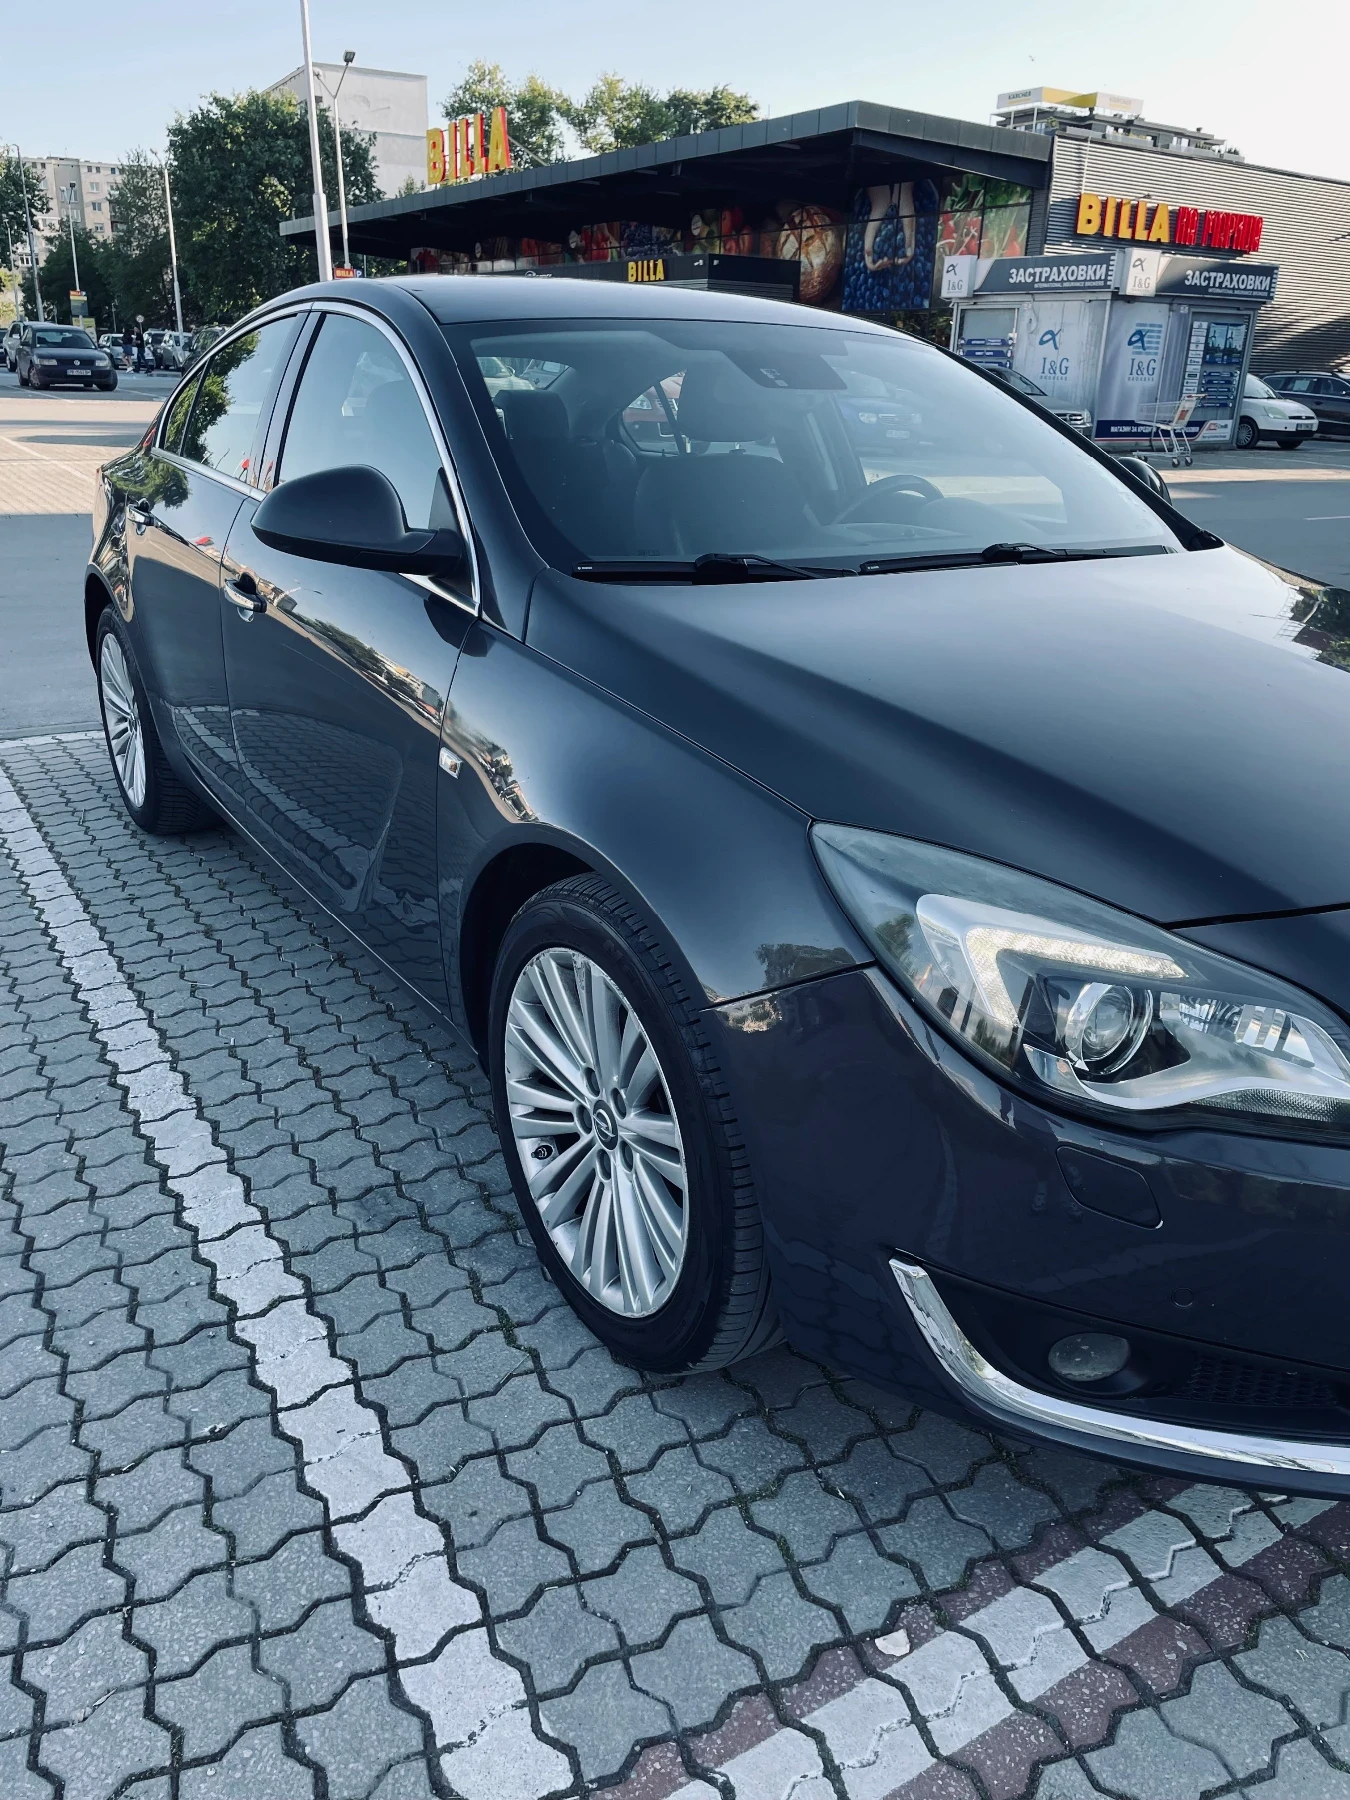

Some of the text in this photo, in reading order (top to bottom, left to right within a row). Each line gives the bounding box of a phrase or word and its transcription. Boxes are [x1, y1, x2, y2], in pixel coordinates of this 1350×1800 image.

[426, 106, 511, 185] BILLA
[1076, 192, 1170, 243] BILLA
[628, 258, 665, 283] BILLA
[1008, 264, 1107, 284] ЗАСТРАХОВКИ
[1184, 269, 1271, 291] ЗАСТРАХОВКИ
[947, 279, 964, 291] I&G
[1132, 275, 1151, 289] I&G
[1041, 357, 1069, 376] I&G
[1129, 358, 1156, 376] I&G
